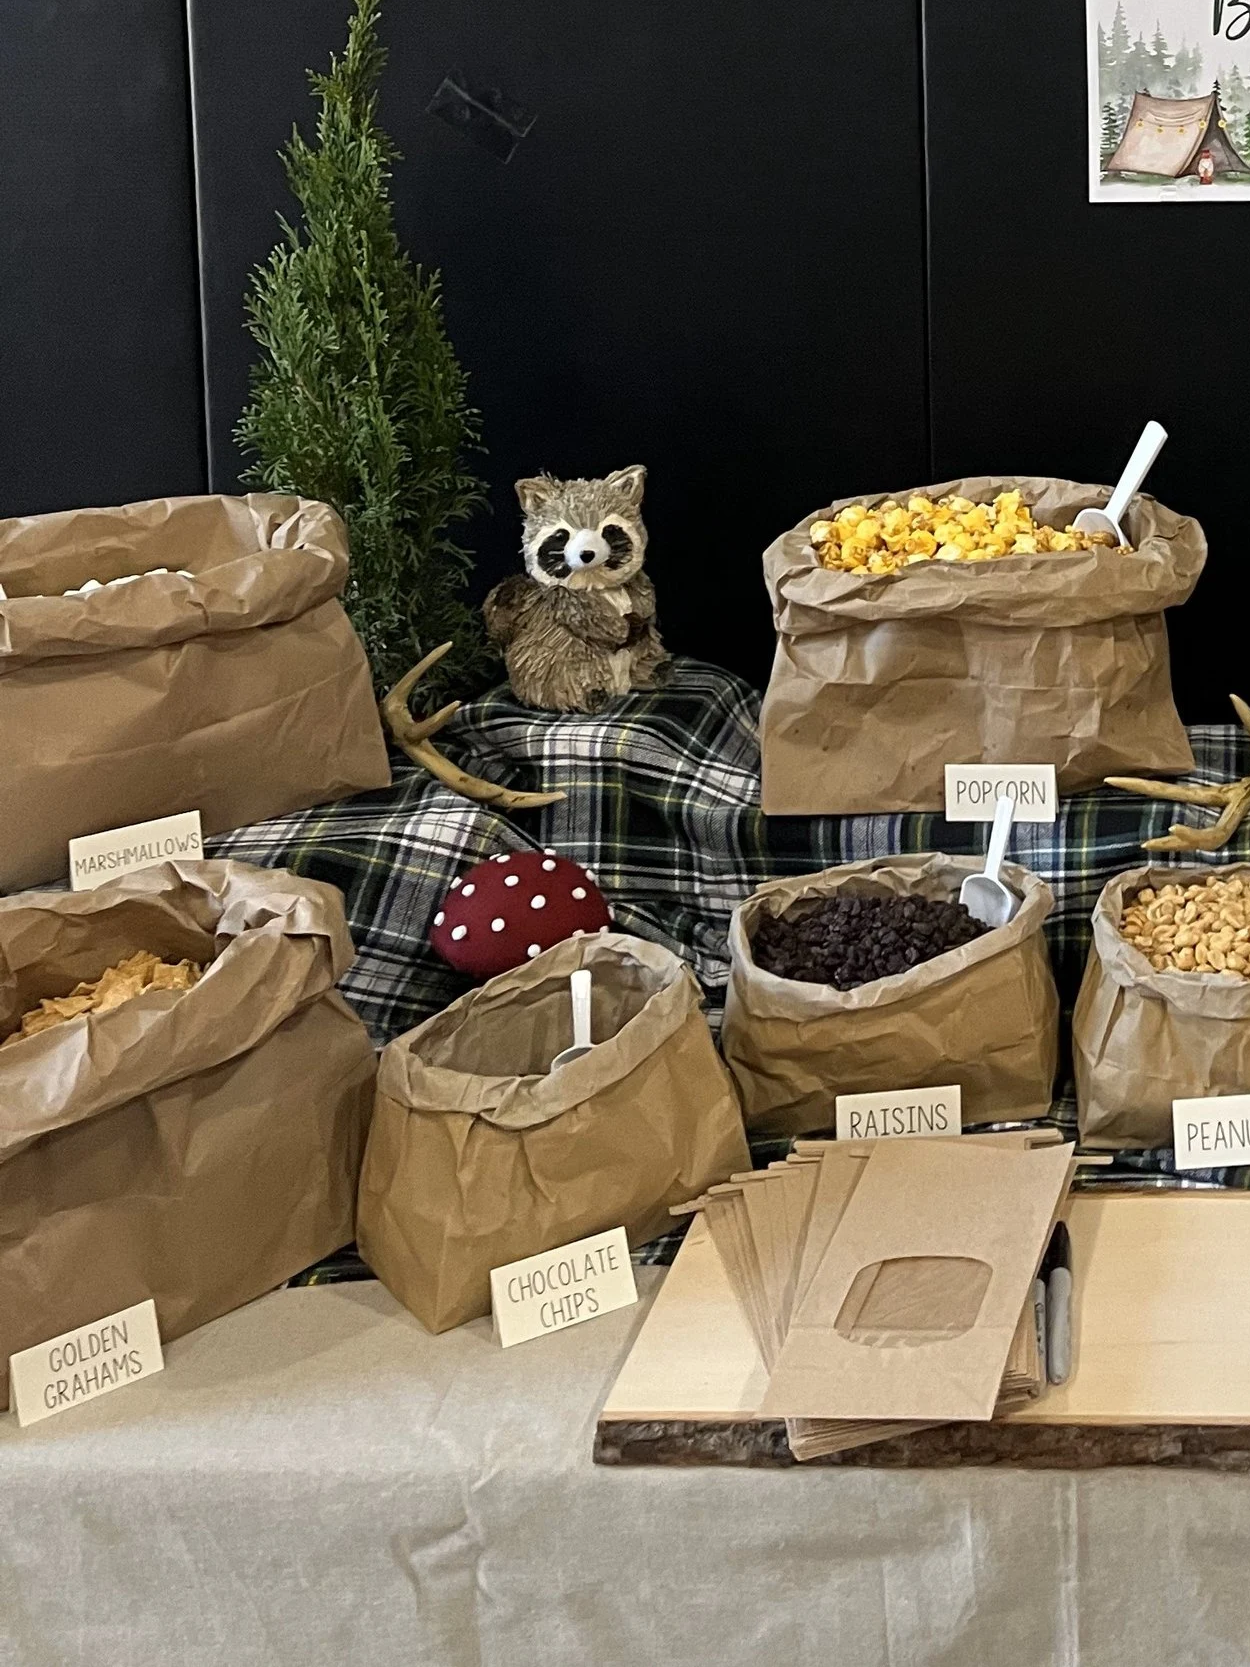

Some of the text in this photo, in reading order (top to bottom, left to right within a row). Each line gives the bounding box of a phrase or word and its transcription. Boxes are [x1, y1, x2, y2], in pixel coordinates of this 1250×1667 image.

[956, 780, 1046, 805] POPCORN
[74, 832, 200, 877] MARSHMALLOWS
[850, 1103, 948, 1138] RAISINS
[507, 1244, 619, 1303] CHOCOLATE
[540, 1287, 599, 1328] CHIPS
[49, 1320, 128, 1372] GOLDEN
[43, 1350, 143, 1409] GRAHAMS
